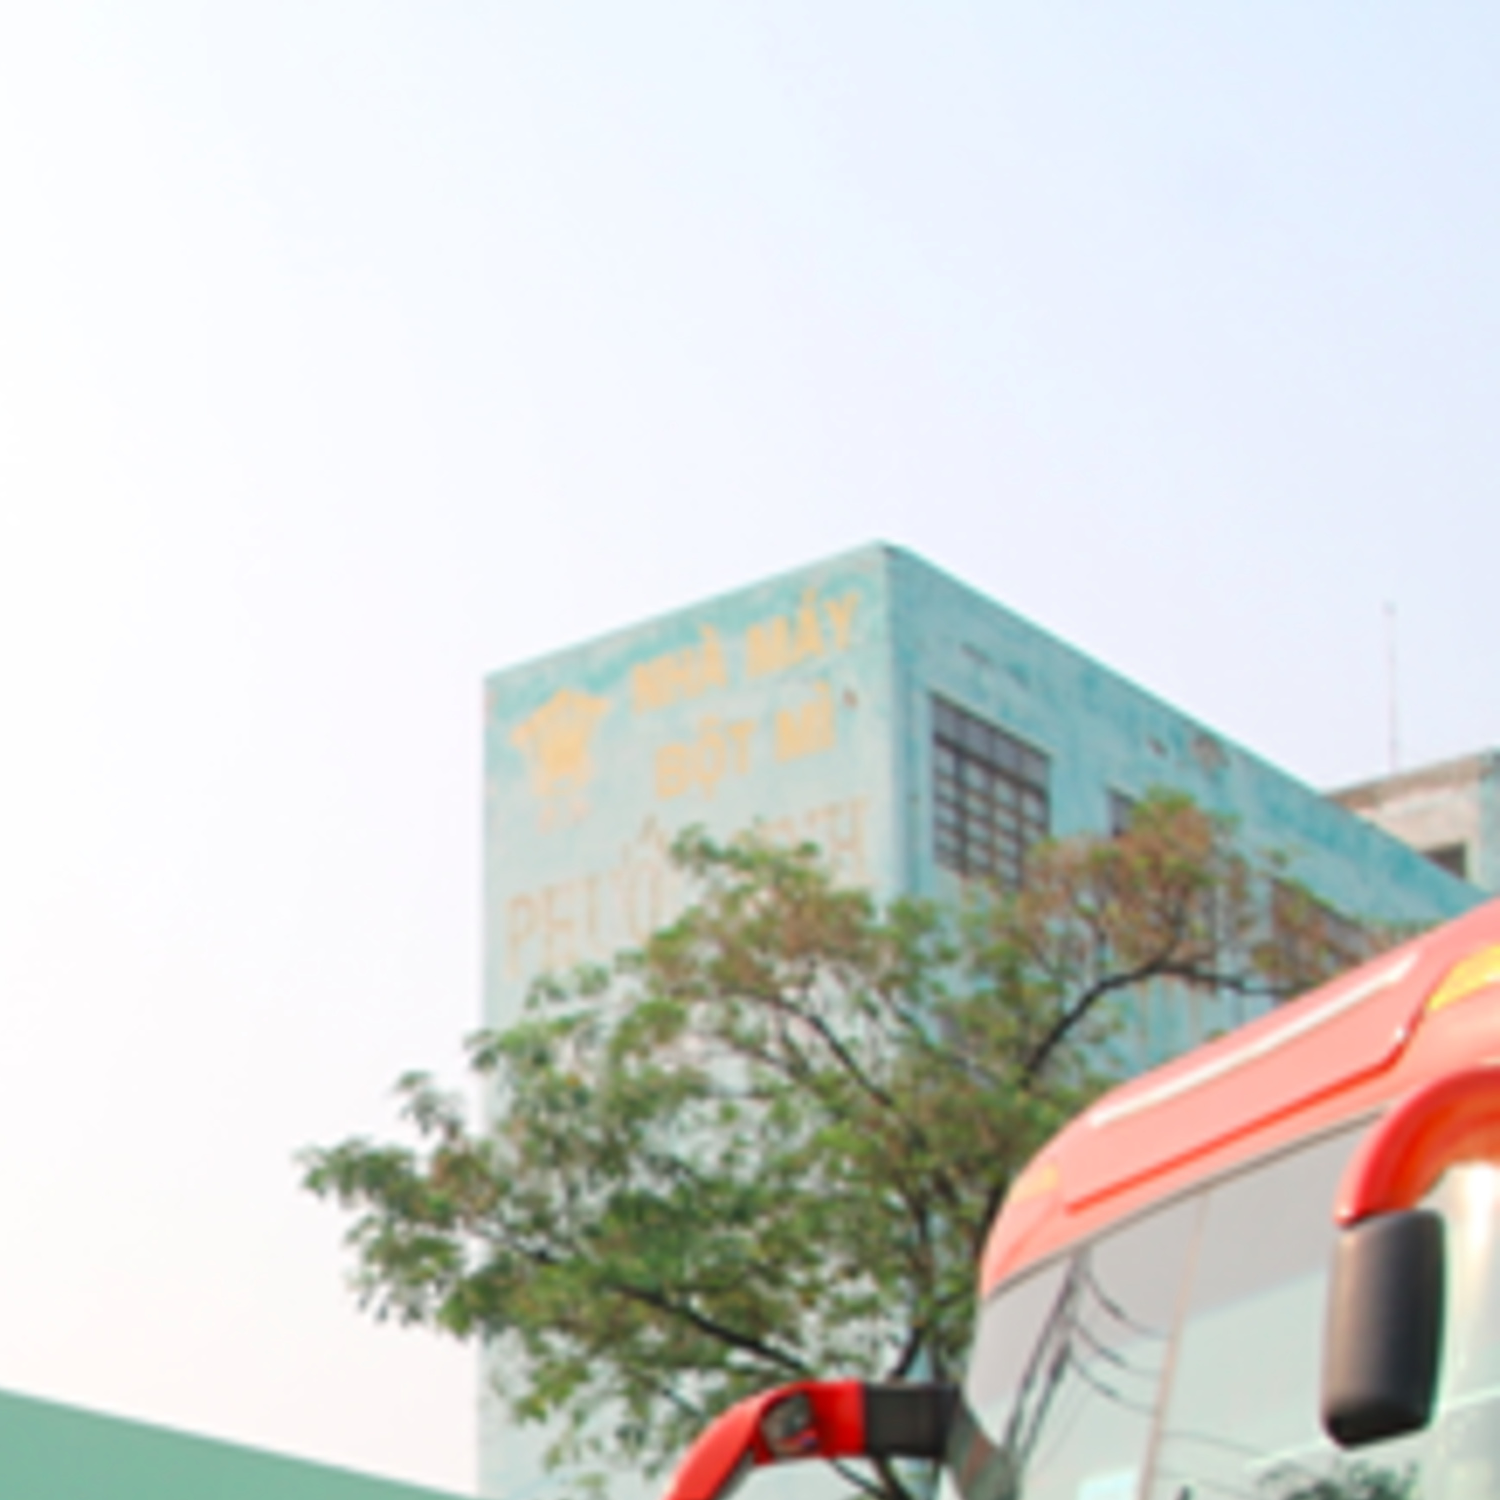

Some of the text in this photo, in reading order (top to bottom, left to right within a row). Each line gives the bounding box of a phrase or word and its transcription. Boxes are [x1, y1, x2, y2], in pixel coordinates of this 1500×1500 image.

[632, 588, 859, 714] NHÀ MÁY
[655, 715, 756, 801] BỘT
